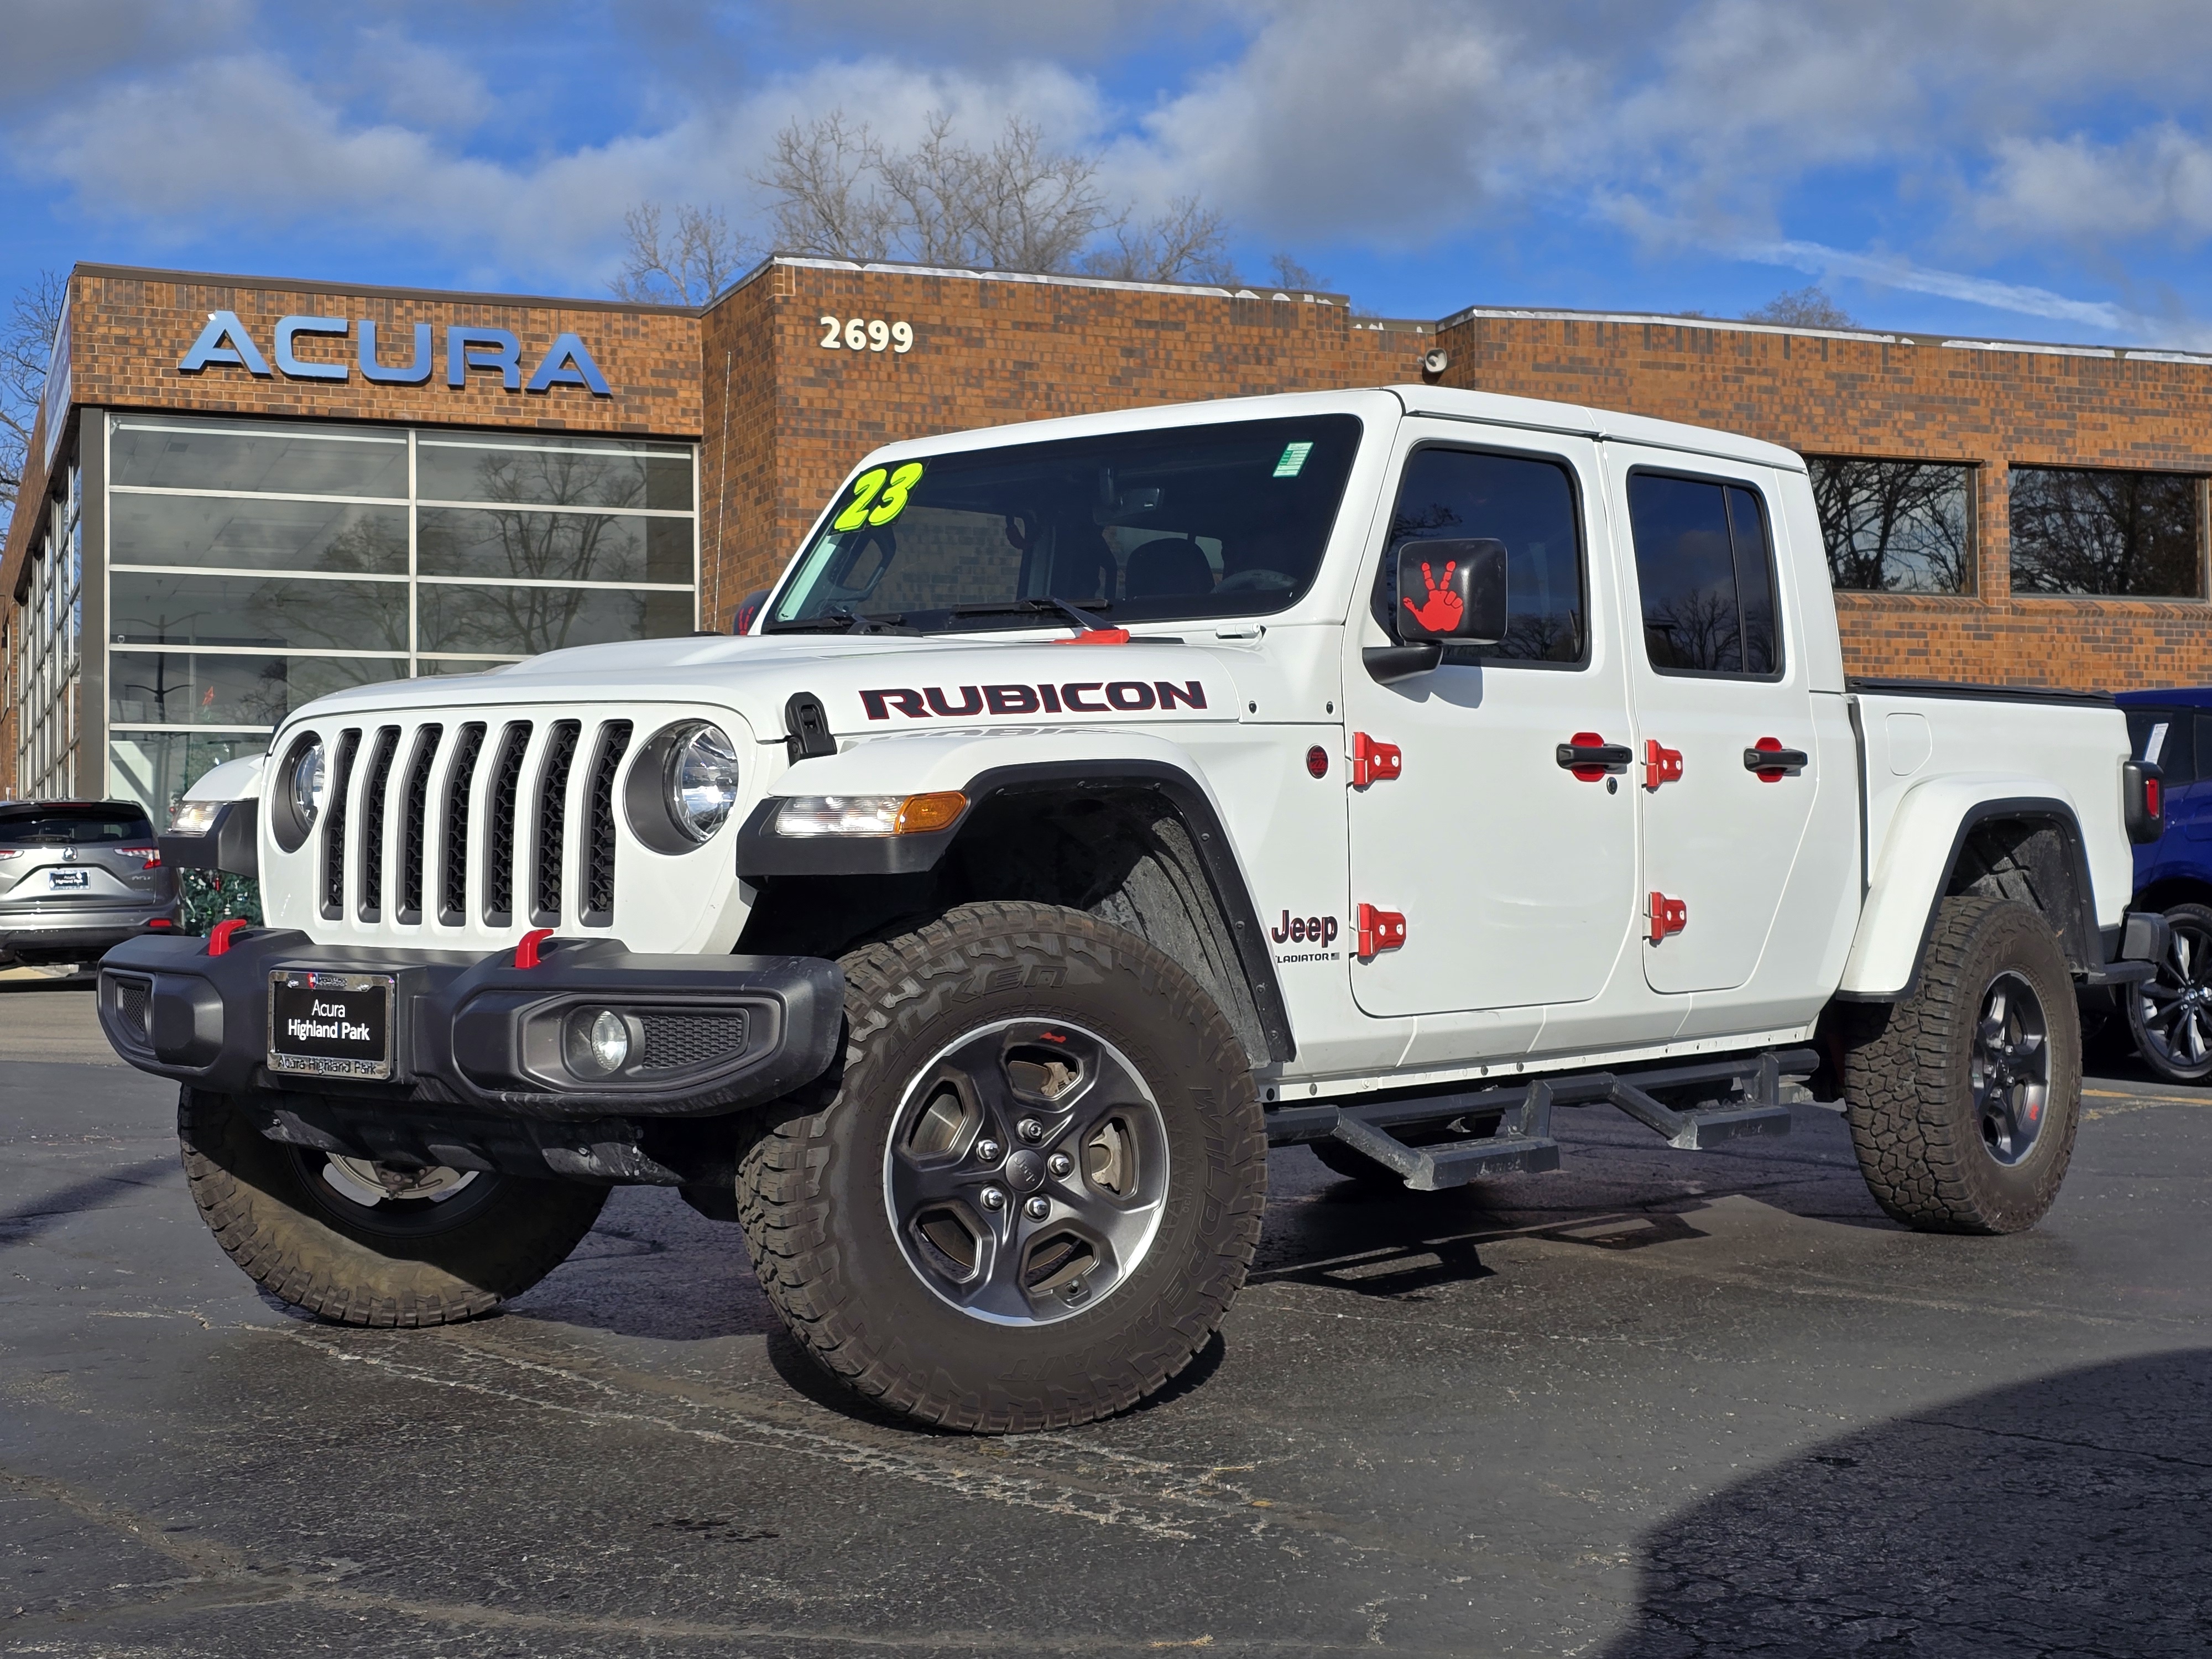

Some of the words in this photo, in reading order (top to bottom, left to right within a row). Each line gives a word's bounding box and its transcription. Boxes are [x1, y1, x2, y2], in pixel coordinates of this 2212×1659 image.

[820, 316, 914, 353] 2699
[178, 310, 612, 395] ACURA
[833, 462, 924, 533] 23
[858, 680, 1208, 721] RUBICON
[1271, 909, 1338, 948] Jeep
[1275, 952, 1329, 963] LADIATOR
[311, 999, 346, 1018] Acura
[288, 1018, 338, 1041] Highland
[341, 1022, 371, 1041] Park
[278, 1055, 305, 1070] Acura
[308, 1057, 351, 1074] Highland
[354, 1061, 377, 1074] Park
[1014, 1155, 1037, 1185] Jeep
